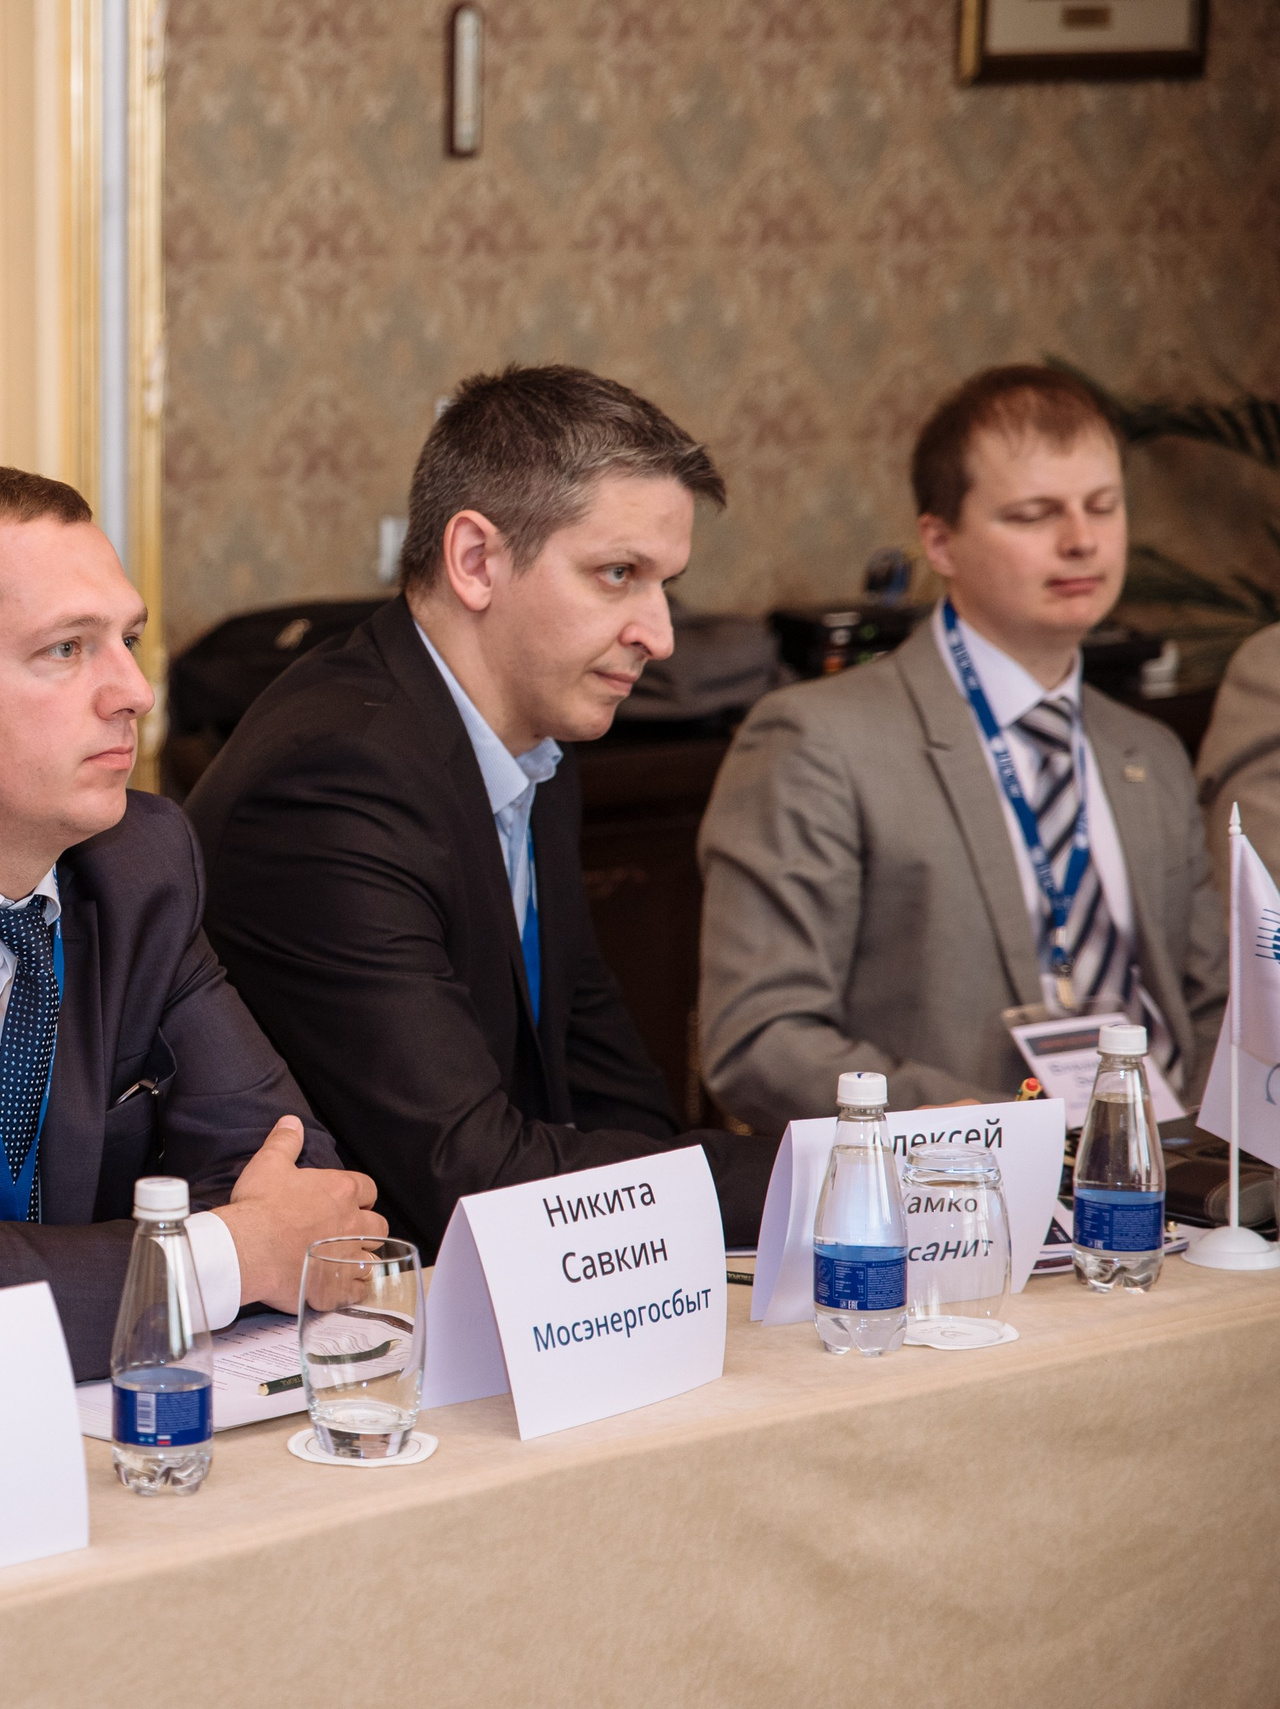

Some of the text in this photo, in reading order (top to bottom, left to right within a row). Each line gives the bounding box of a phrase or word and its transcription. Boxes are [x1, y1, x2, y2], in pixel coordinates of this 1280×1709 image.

[542, 1181, 656, 1228] Никита
[903, 1193, 978, 1215] амко
[561, 1237, 668, 1284] Савкин
[907, 1239, 994, 1262] санит
[532, 1288, 712, 1353] Мосэнергосбыт
